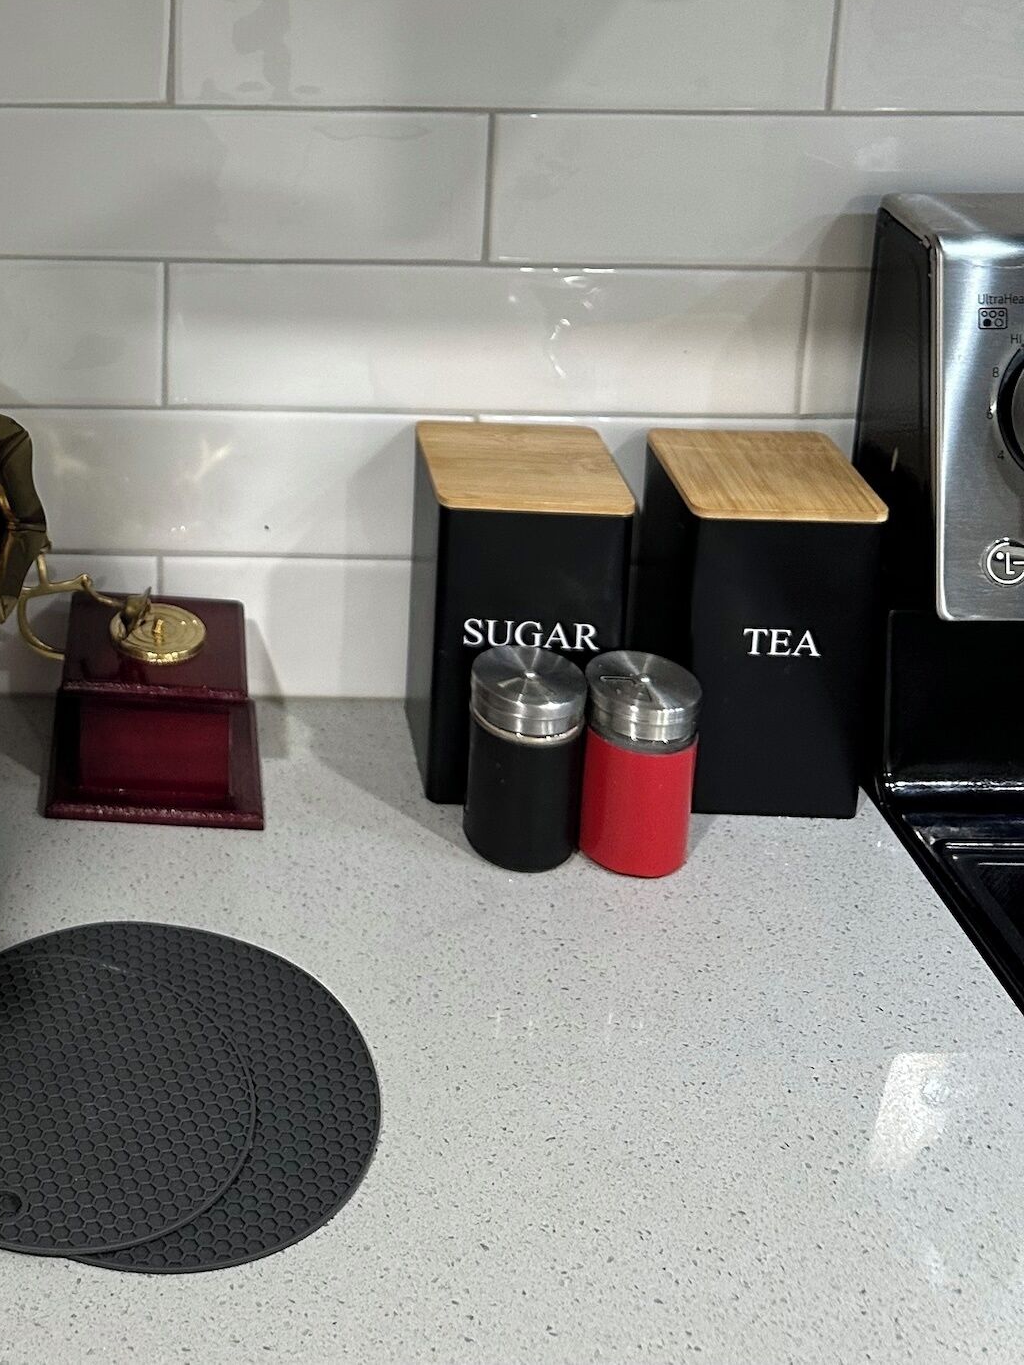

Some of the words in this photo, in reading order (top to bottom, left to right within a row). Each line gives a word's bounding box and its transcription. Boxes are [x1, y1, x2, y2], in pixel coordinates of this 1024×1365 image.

[992, 366, 1000, 378] 8
[462, 618, 601, 652] SUGAR
[742, 627, 822, 658] TEA
